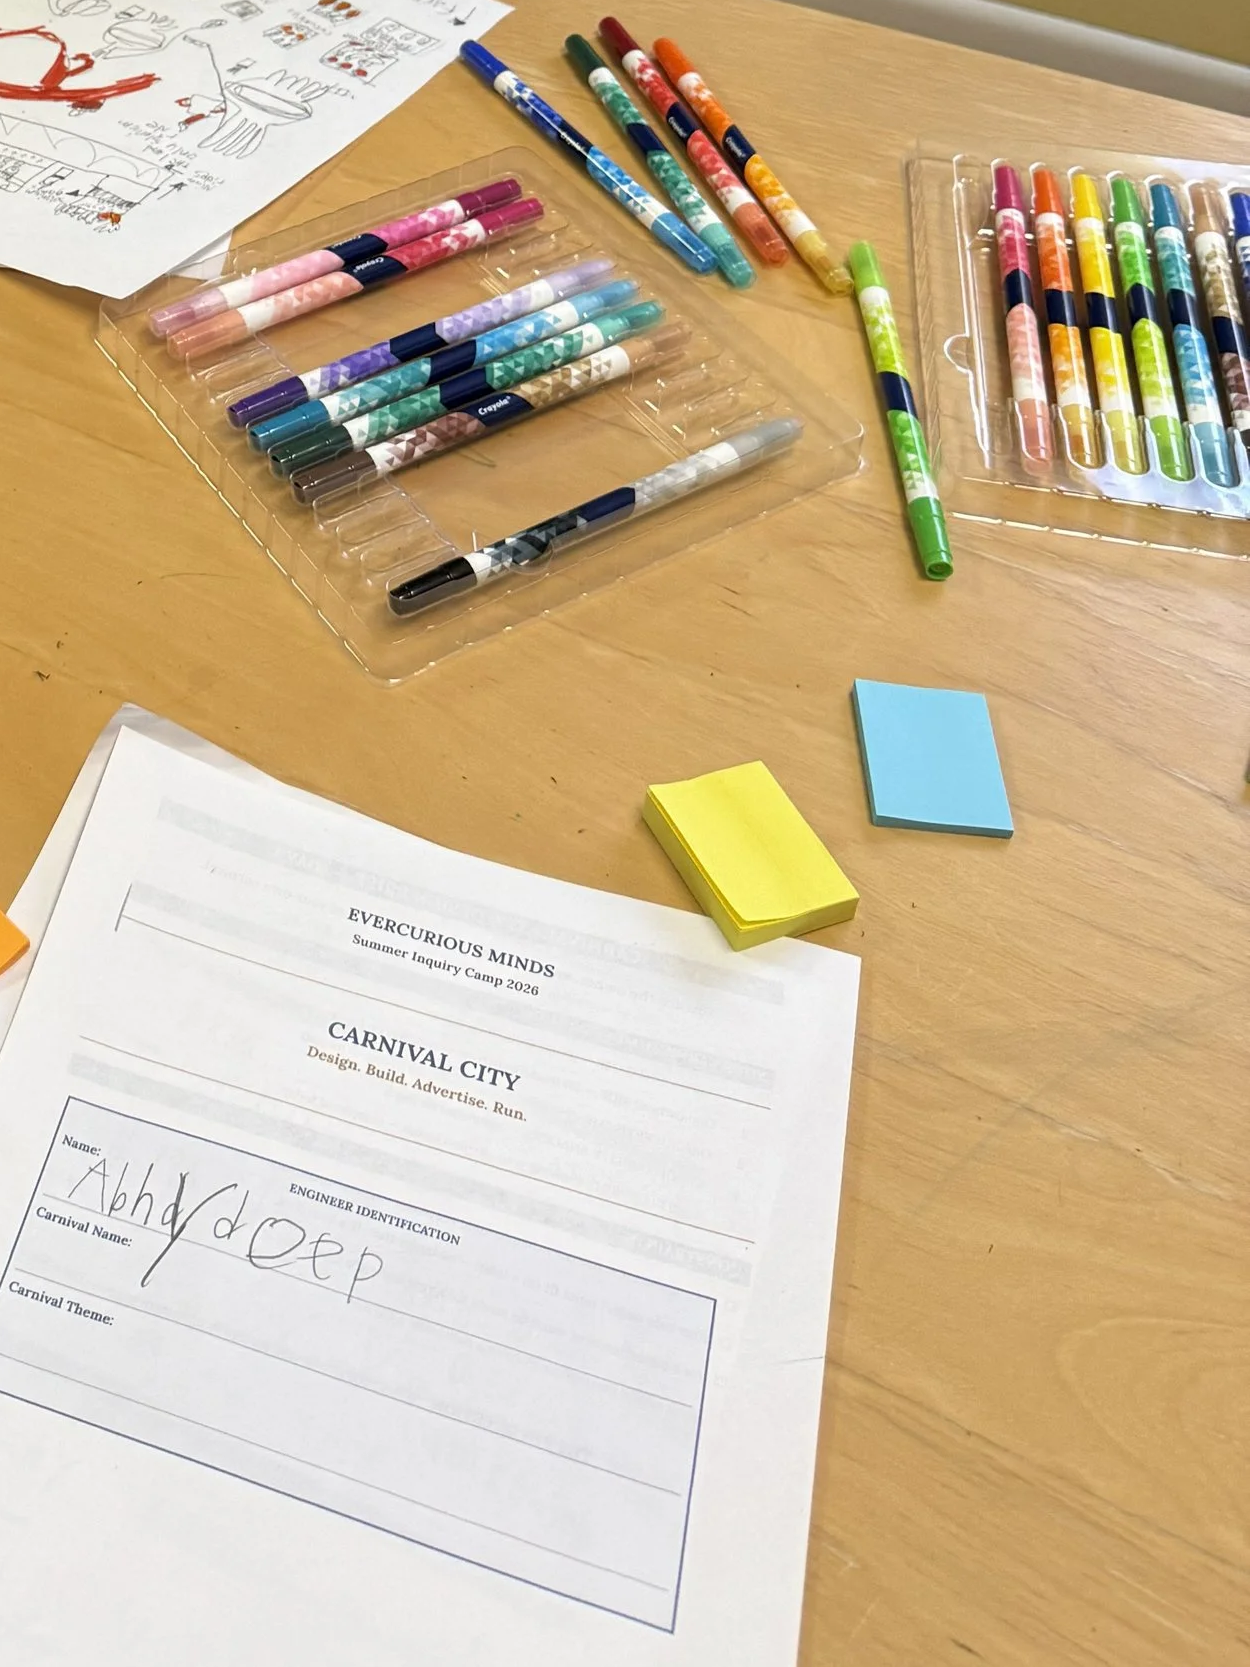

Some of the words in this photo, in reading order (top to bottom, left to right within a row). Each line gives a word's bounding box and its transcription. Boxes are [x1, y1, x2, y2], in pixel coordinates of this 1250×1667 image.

[352, 257, 384, 273] Crayola
[478, 396, 510, 415] Crayola
[347, 907, 483, 957] EVERCURIOUS
[488, 949, 555, 978] MINDS
[352, 934, 408, 958] Summer
[412, 951, 461, 975] Inquiry
[465, 967, 503, 988] Camp
[507, 978, 539, 996] 2026
[307, 1045, 361, 1072] Design.
[365, 1063, 408, 1086] Build.
[411, 1078, 488, 1110] Advertise.
[493, 1101, 527, 1121] Run.
[328, 1022, 453, 1072] CARNIVAL
[460, 1060, 521, 1091] CITY
[62, 1134, 102, 1157] Name:
[36, 1206, 89, 1233] Carnival
[92, 1225, 132, 1248] Name:
[289, 1182, 353, 1212] ENGINEER
[355, 1204, 461, 1246] IDENTIFICATION
[9, 1281, 64, 1309] Carnival
[66, 1300, 115, 1326] Theme:
